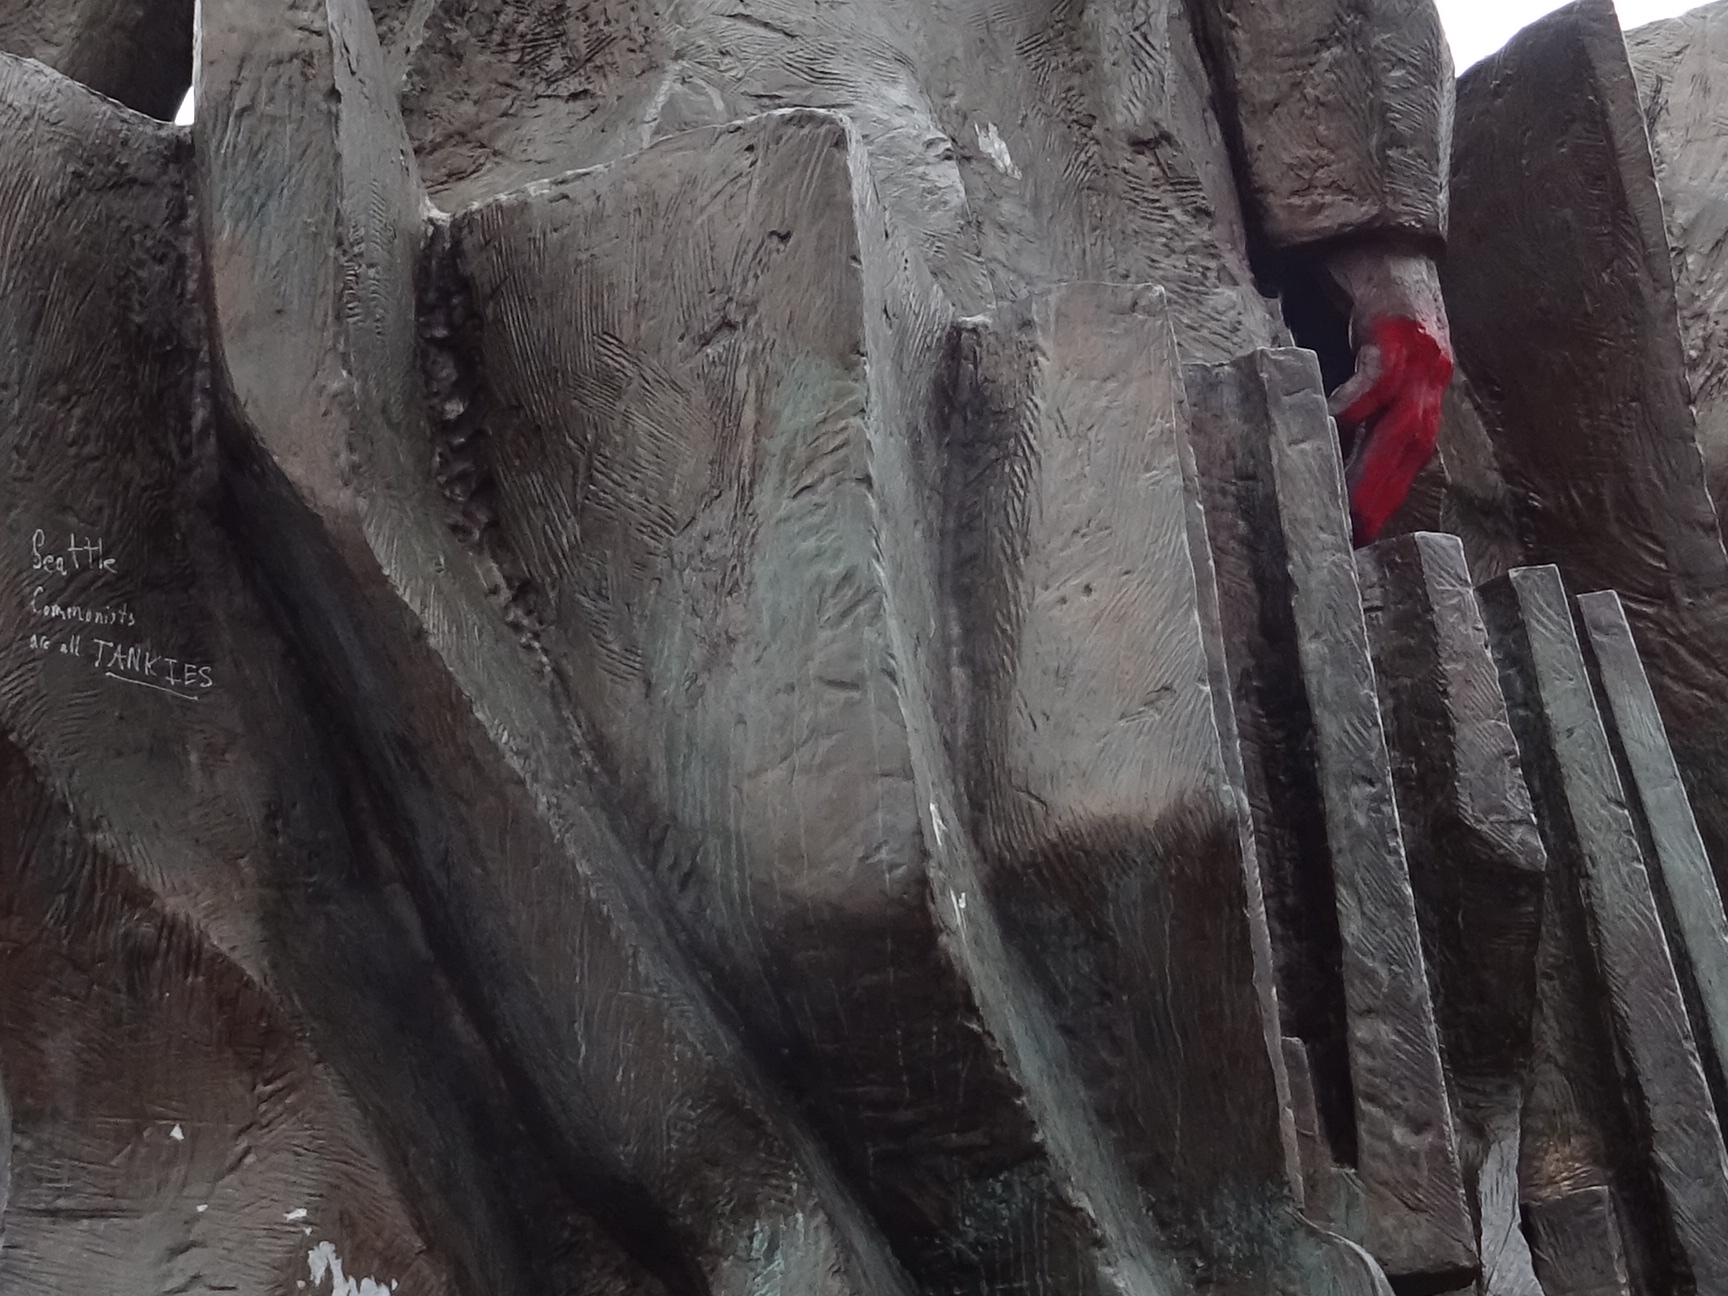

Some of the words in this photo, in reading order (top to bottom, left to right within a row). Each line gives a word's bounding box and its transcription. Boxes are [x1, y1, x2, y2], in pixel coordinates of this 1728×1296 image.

[32, 528, 118, 576] Seattle
[59, 635, 81, 656] all
[93, 638, 214, 688] TANKIES
